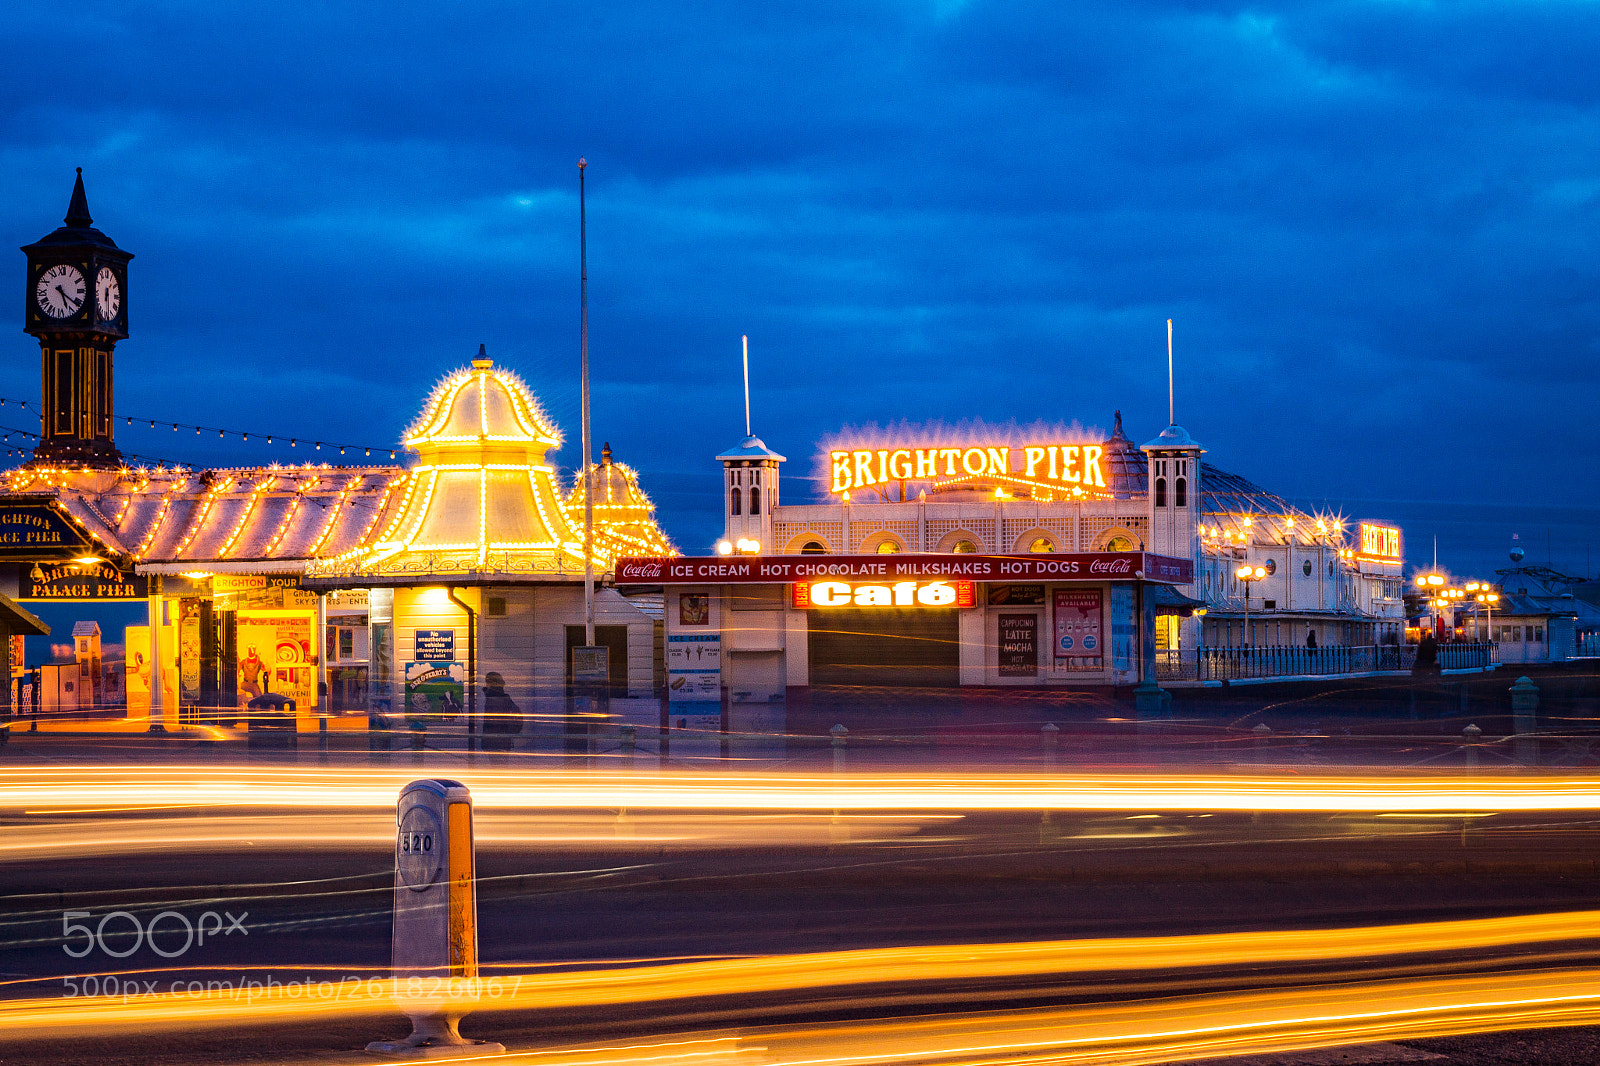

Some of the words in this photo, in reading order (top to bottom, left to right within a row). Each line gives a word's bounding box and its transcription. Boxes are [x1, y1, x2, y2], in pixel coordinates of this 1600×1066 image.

[830, 447, 1009, 494] BRIGHTON
[1025, 445, 1106, 488] PIER
[0, 513, 53, 531] GHTON
[26, 531, 62, 542] PIER
[42, 564, 125, 584] BRIGHTON
[670, 565, 694, 577] ICE
[698, 564, 750, 576] CREAM
[760, 564, 791, 576] HOT
[795, 563, 887, 576] CHOCOLATE
[895, 562, 991, 575] MILKSHAKES
[1000, 562, 1032, 574] HOT
[1036, 561, 1080, 574] DOGS
[216, 578, 264, 587] BRIGHTON
[270, 578, 297, 587] YOUR
[31, 584, 91, 597] PALACE
[97, 584, 136, 597] PIER
[810, 581, 956, 606] Café
[1005, 630, 1031, 640] LATTE
[1004, 642, 1033, 653] MOCHA
